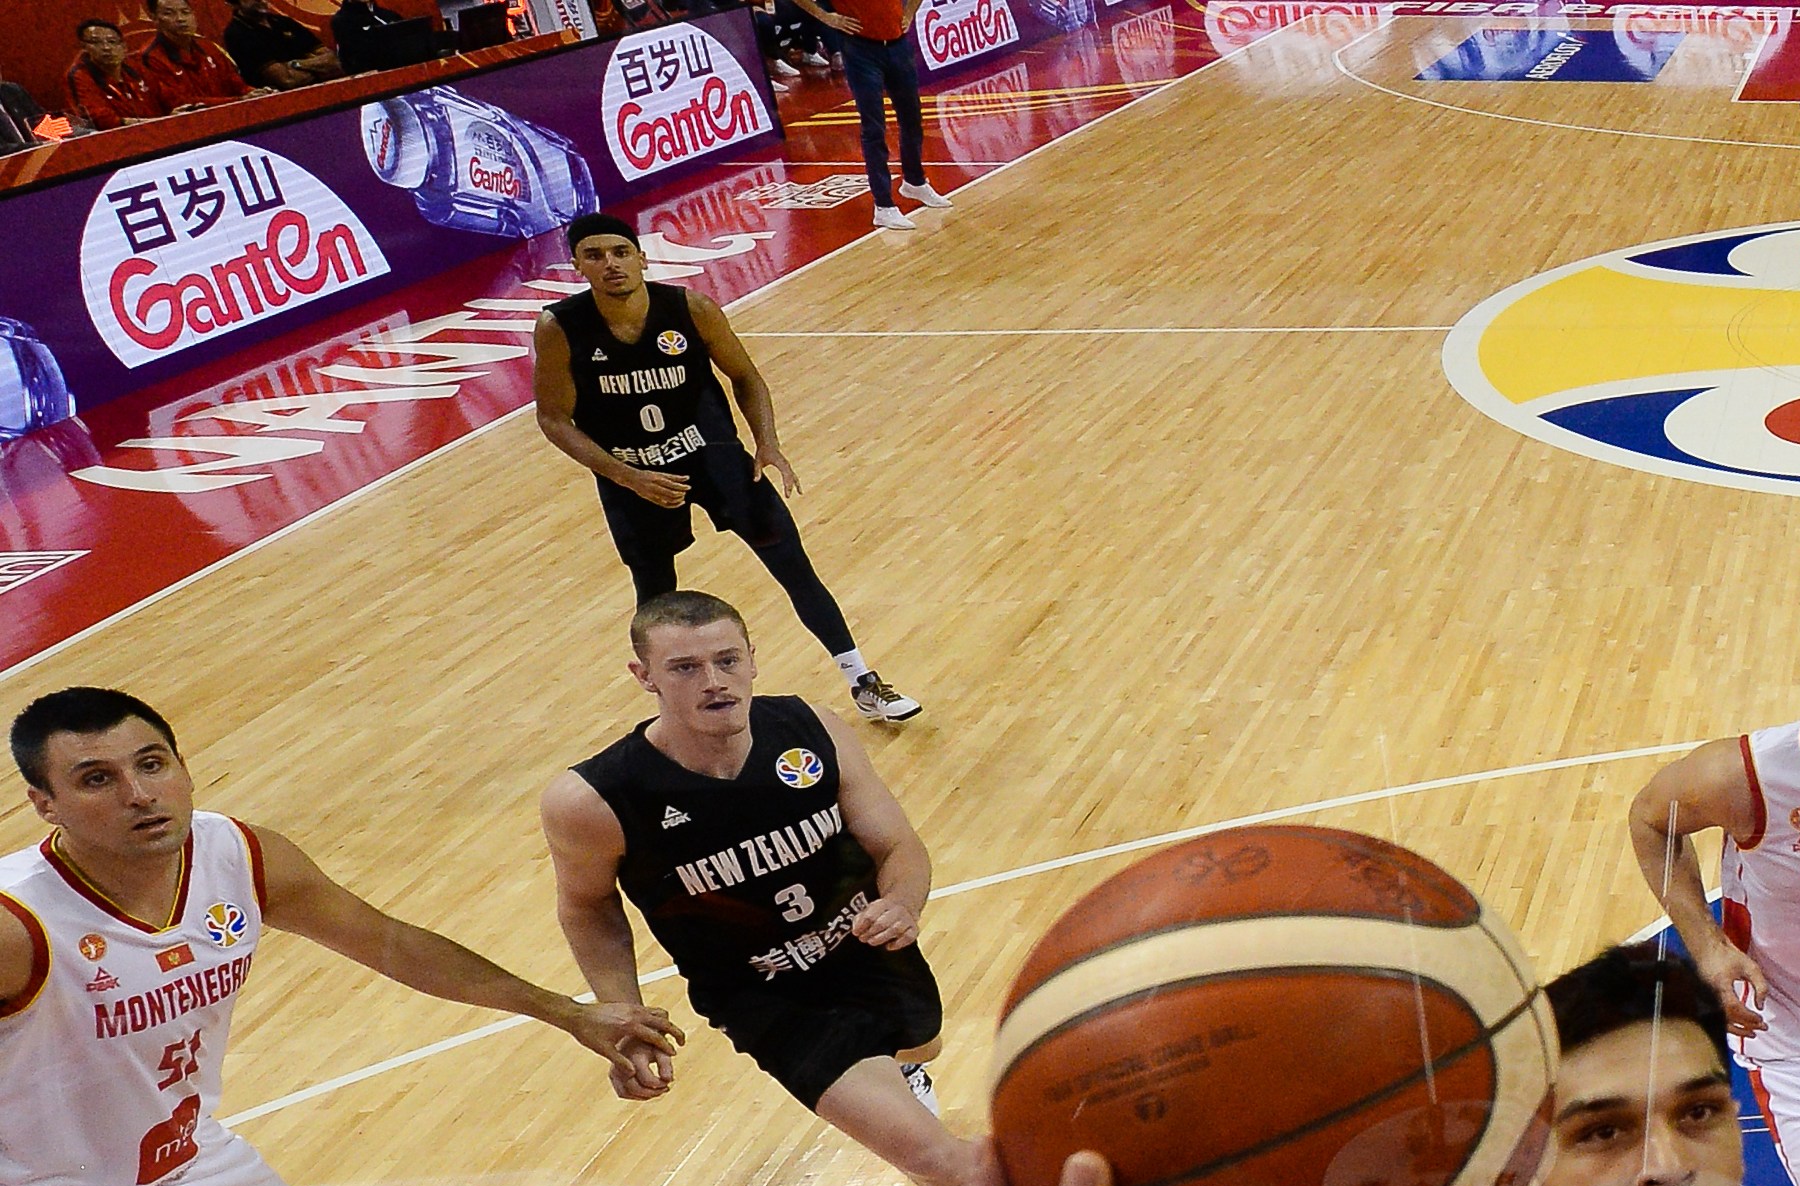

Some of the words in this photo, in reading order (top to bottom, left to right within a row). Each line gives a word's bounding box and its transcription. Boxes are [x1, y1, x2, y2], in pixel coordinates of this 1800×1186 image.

[925, 0, 1011, 63] Ganten
[1381, 1, 1539, 14] FIBA
[616, 34, 714, 99] 百岁山
[616, 77, 758, 170] Ganten
[107, 155, 285, 254] 百岁山
[469, 157, 521, 198] Ganten
[109, 210, 368, 350] Ganten
[599, 373, 630, 395] NEW
[631, 365, 686, 394] ZEALAND
[639, 404, 665, 433] 0
[661, 812, 692, 830] PEAK
[675, 847, 746, 896] NEW
[740, 803, 843, 878] ZEALAND
[774, 883, 815, 923] 3
[94, 952, 253, 1039] MONTENEGRO
